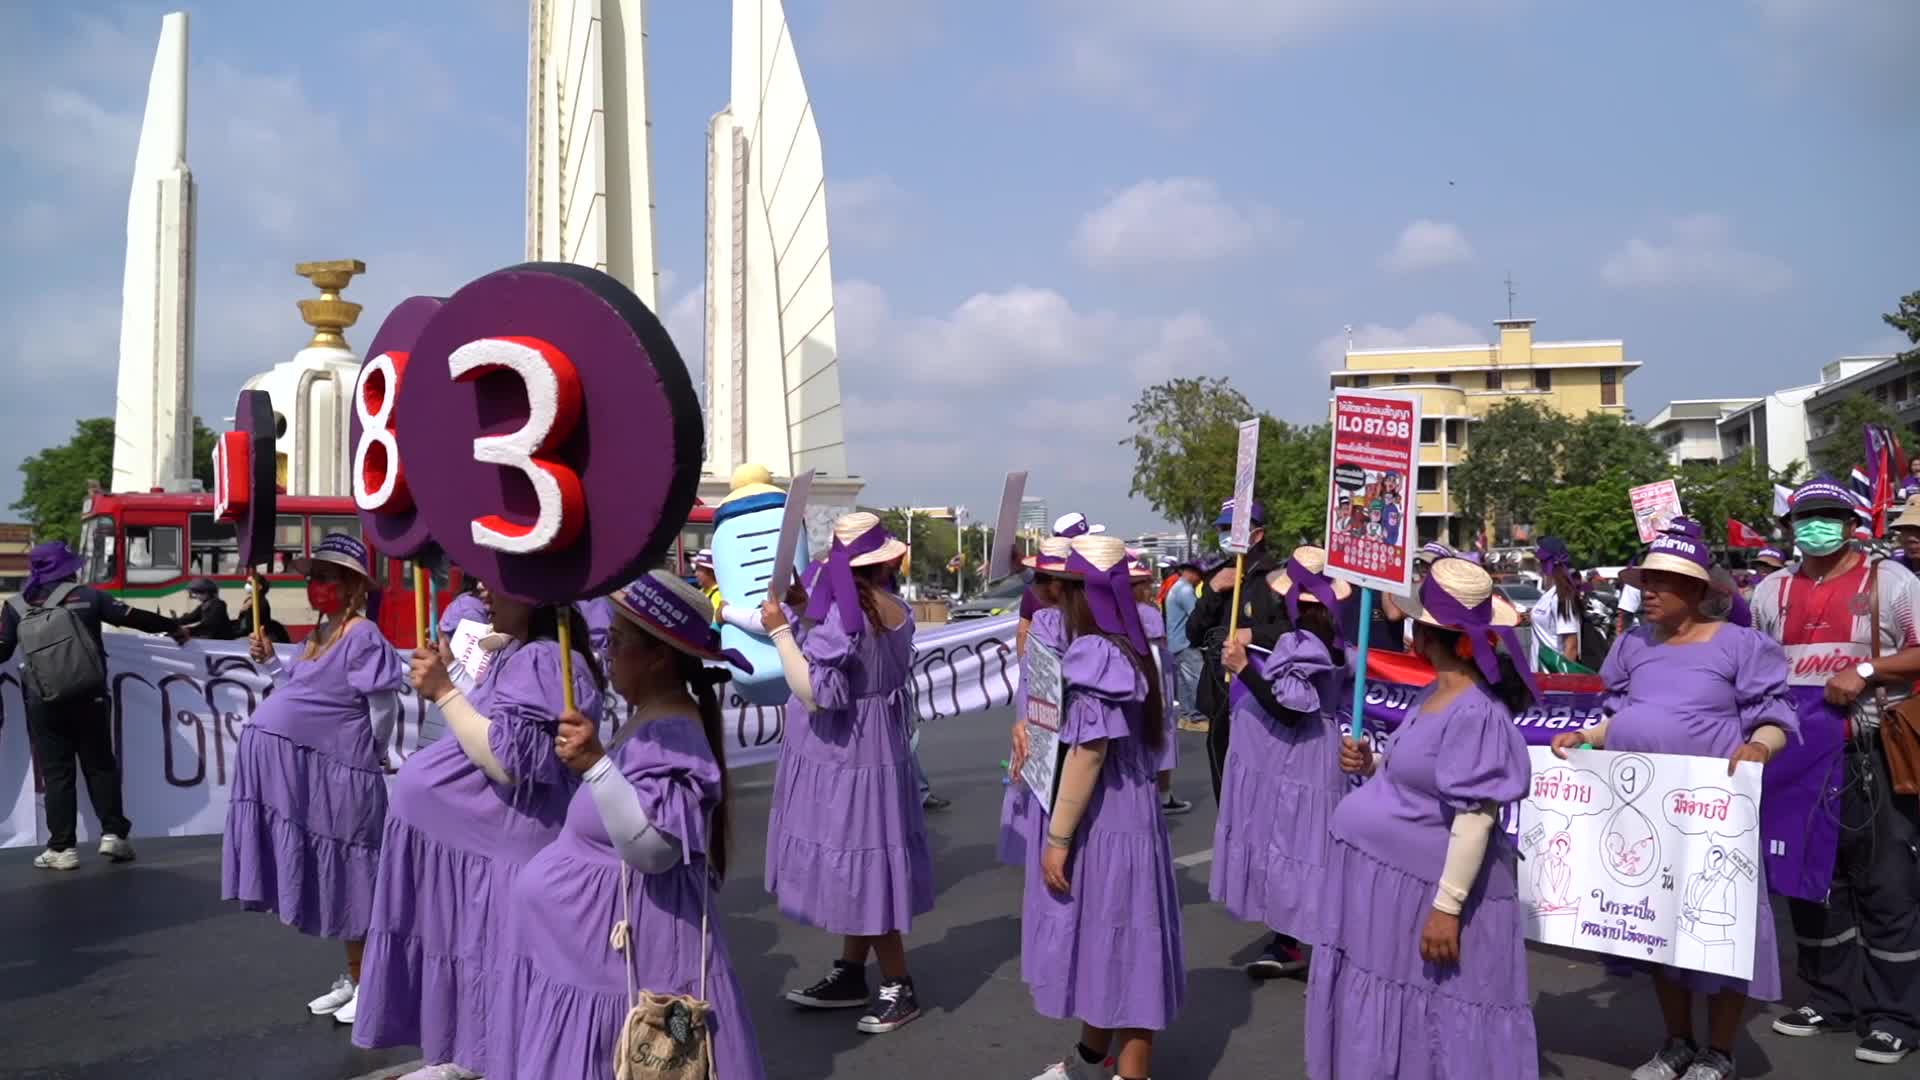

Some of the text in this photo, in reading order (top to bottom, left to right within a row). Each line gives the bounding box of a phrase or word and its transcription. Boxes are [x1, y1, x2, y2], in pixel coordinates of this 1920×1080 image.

[353, 351, 405, 511] 8
[448, 336, 572, 554] 3
[1338, 415, 1362, 433] ILO
[648, 605, 677, 628] Day
